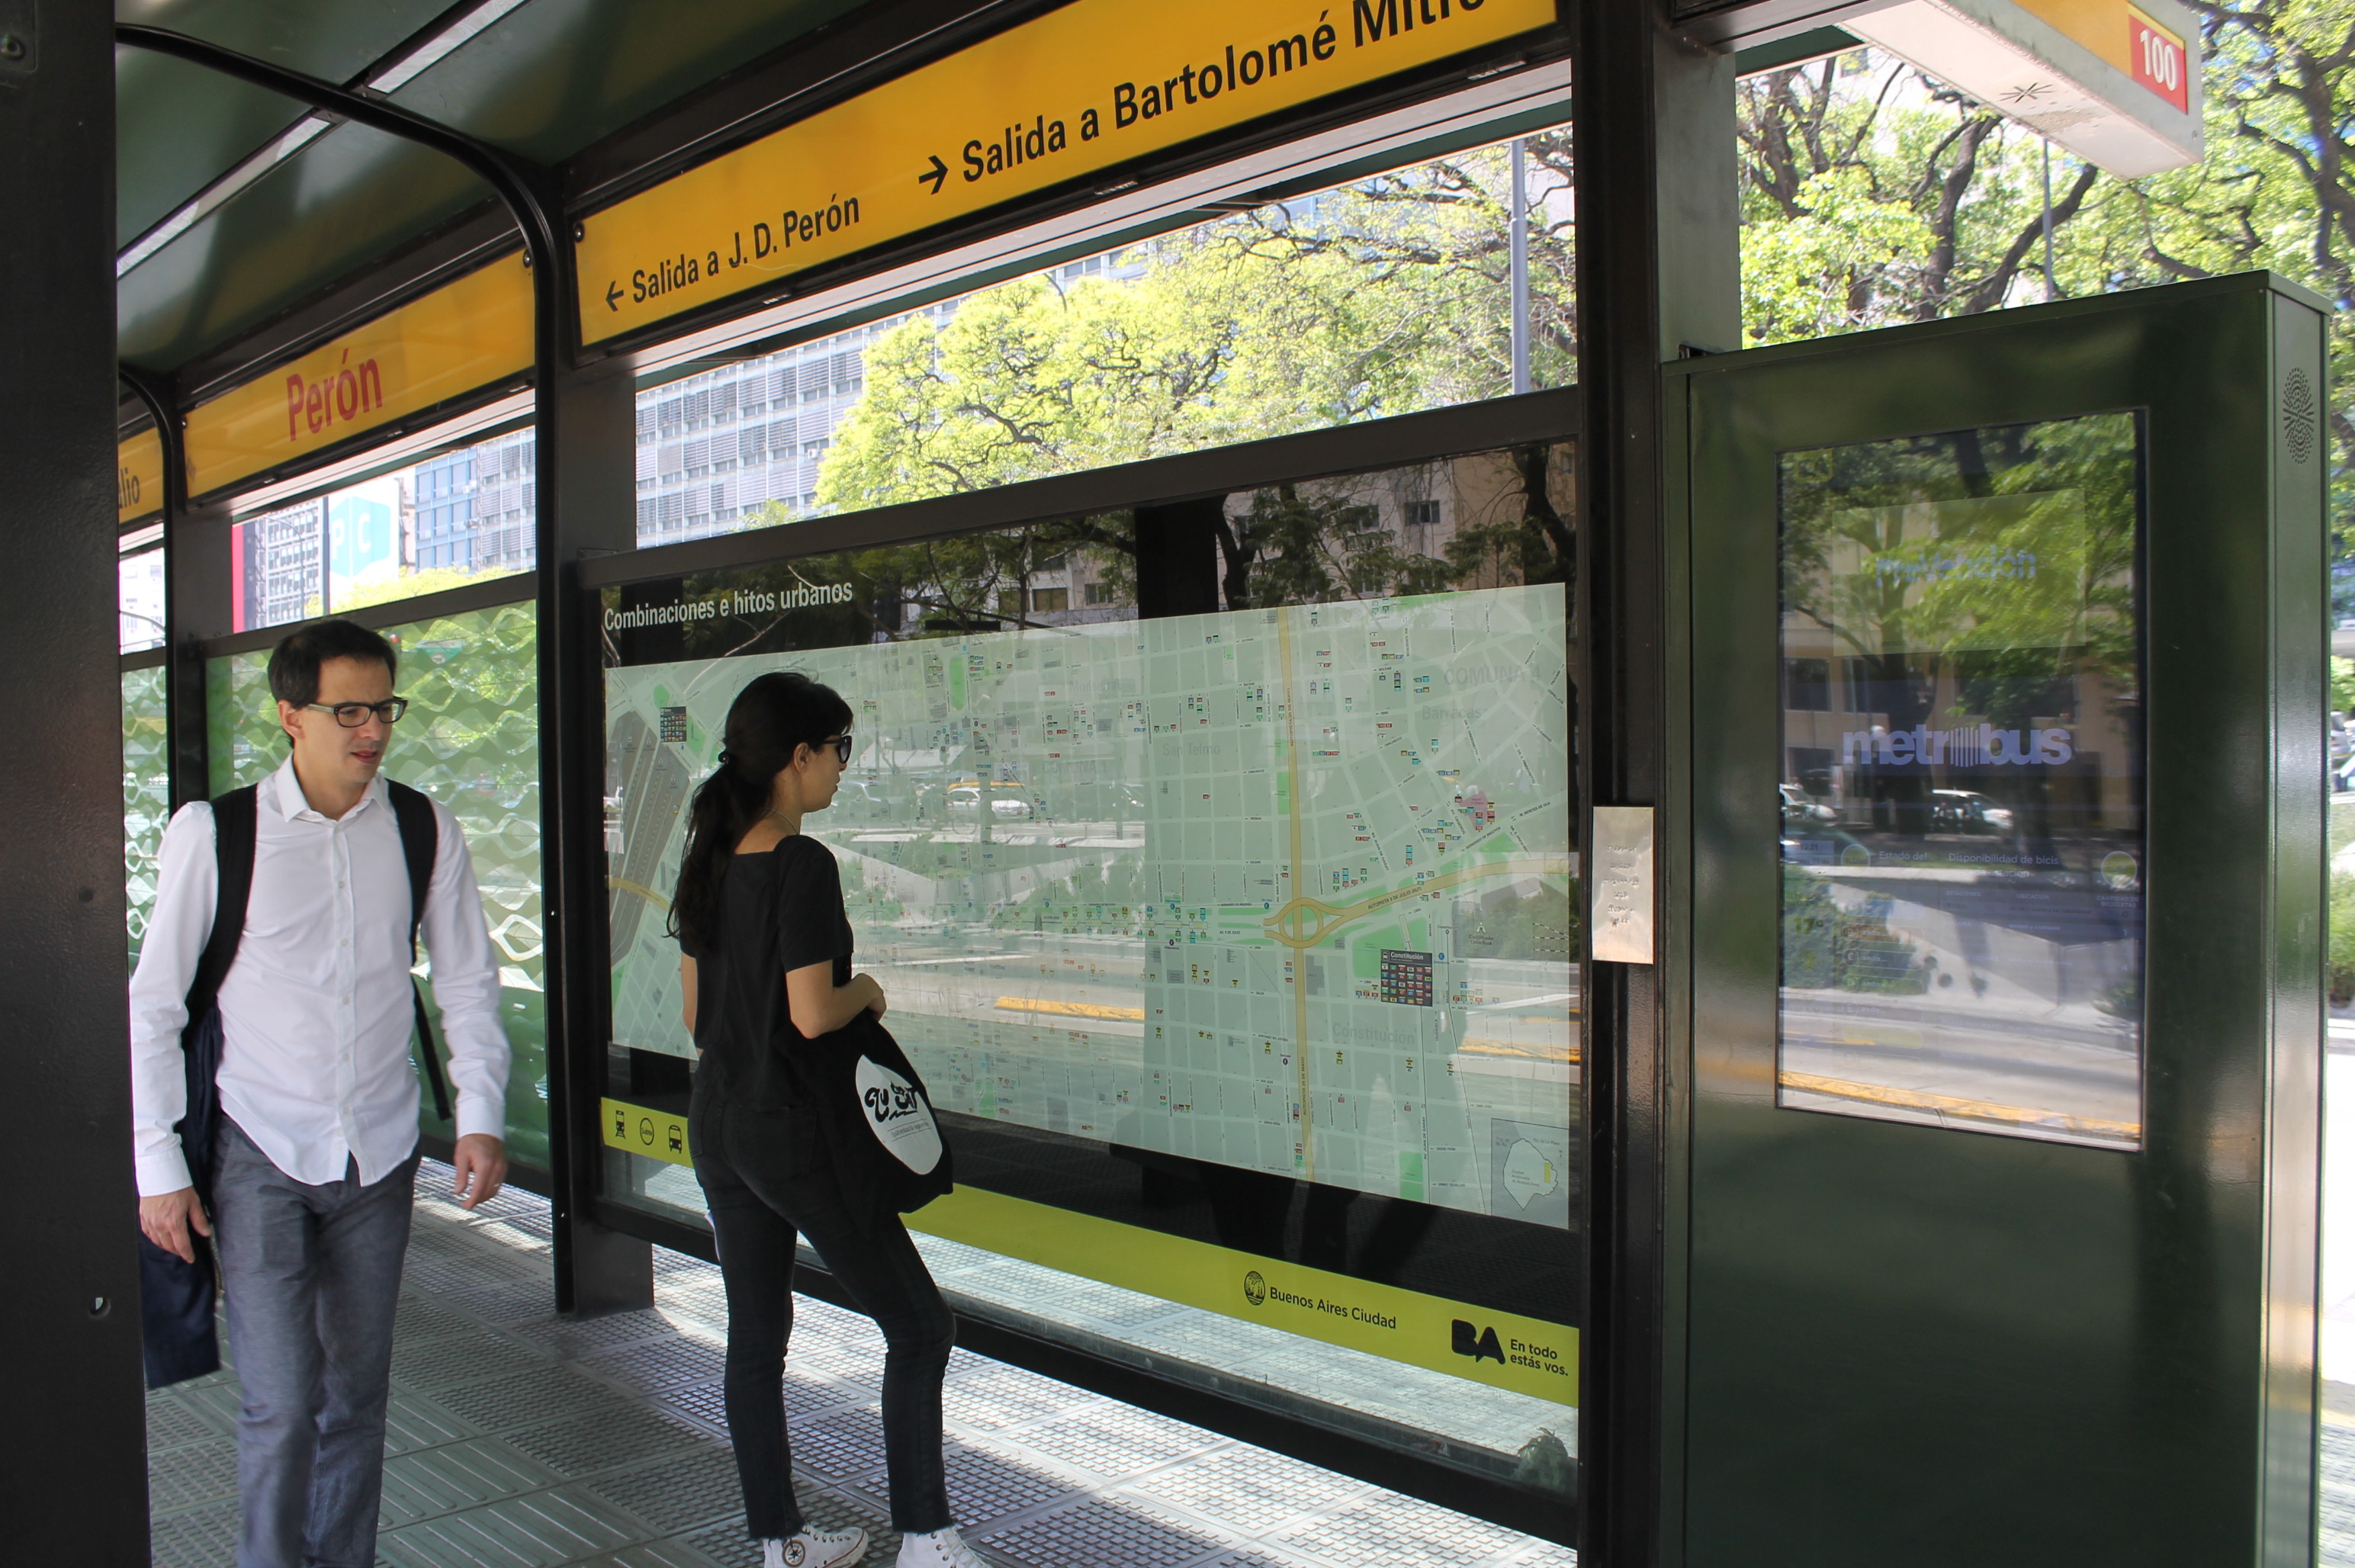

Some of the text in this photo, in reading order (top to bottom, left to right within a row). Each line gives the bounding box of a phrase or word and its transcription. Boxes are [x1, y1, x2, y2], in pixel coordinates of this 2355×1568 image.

[2140, 28, 2177, 92] 100
[962, 0, 1485, 182] Salida a Bartolomé Mit
[632, 192, 860, 304] Salida a J. D. Perón
[287, 349, 382, 442] Perón
[604, 581, 853, 631] Combinaciones e hitos urbanos
[1444, 666, 1524, 685] COMUNA
[1422, 705, 1482, 721] Barracas
[1187, 742, 1220, 756] Telmo
[1879, 850, 1926, 861] Estado del
[1949, 853, 2059, 865] Disponibilidad de bicis
[1390, 952, 1424, 961] Constitución
[1332, 1023, 1415, 1046] Constitución
[1270, 1287, 1397, 1330] Buenos Aires Ciudad
[1451, 1318, 1506, 1365] BA
[1510, 1338, 1558, 1361] En todo
[1510, 1352, 1569, 1377] estás vos.
